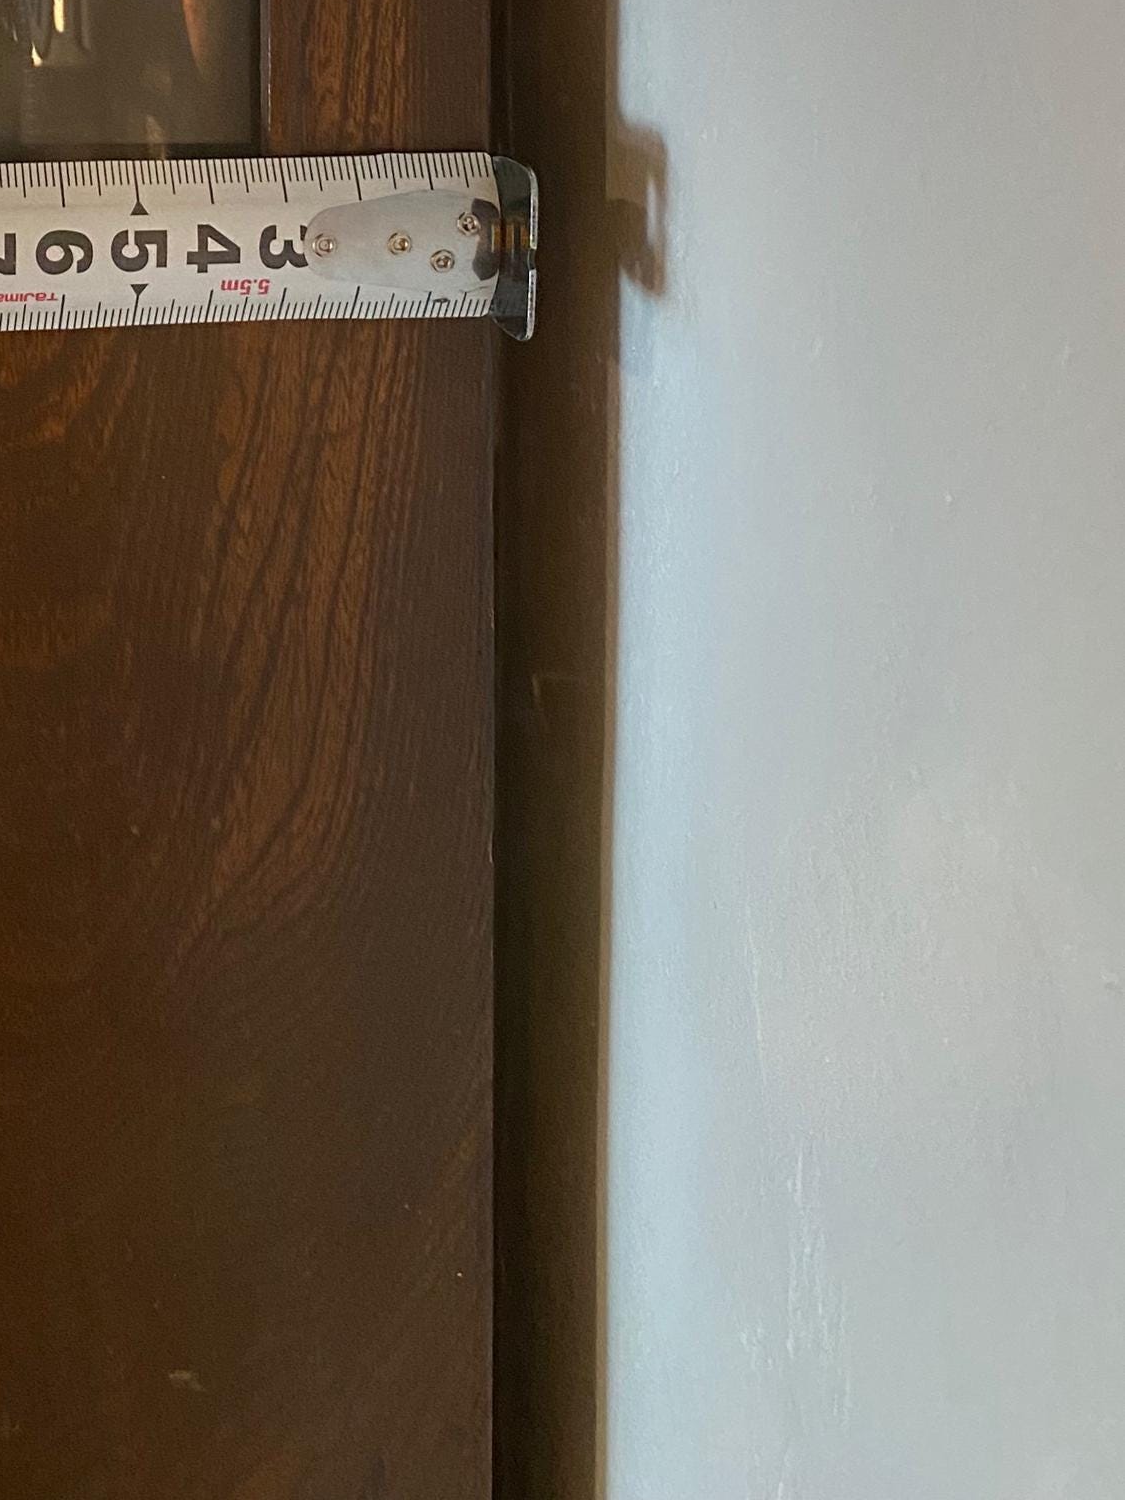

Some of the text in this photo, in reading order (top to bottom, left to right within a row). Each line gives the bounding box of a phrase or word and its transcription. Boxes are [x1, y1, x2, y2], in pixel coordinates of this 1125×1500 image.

[35, 229, 94, 275] 6
[111, 229, 168, 274] 5
[187, 224, 241, 274] 4
[259, 224, 308, 269] 3
[220, 278, 271, 296] 5.5m
